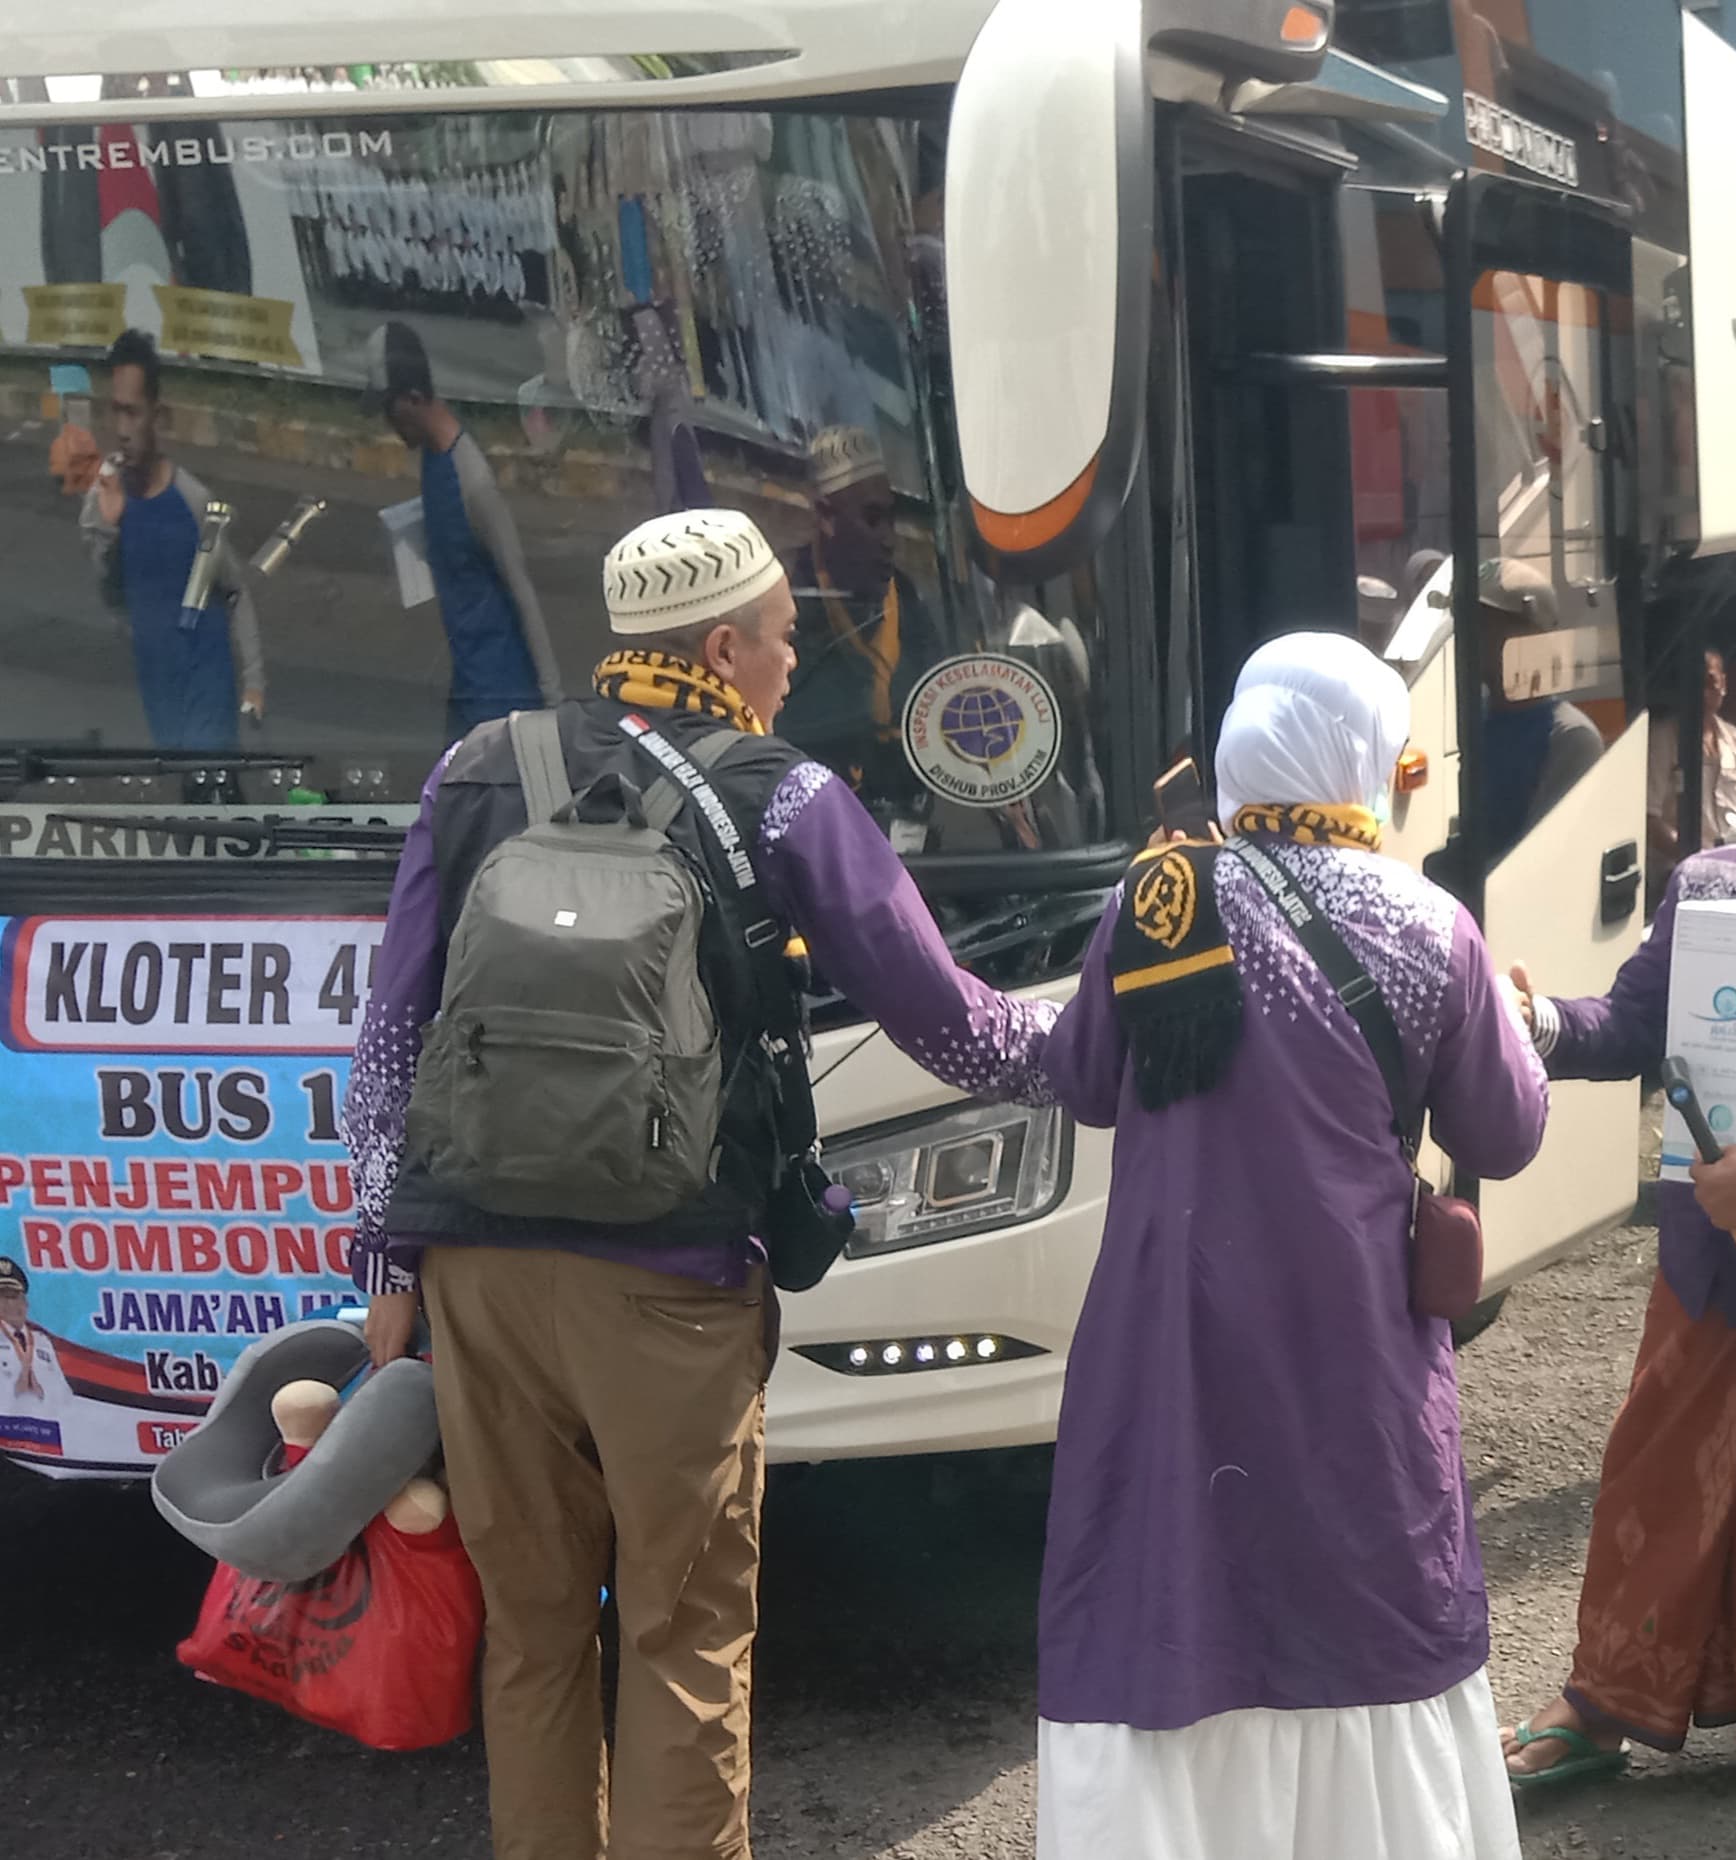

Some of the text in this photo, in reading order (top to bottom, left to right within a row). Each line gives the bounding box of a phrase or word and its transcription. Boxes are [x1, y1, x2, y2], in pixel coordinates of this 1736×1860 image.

[929, 763, 978, 796] DISHUB
[44, 940, 384, 1026] KLOTER 4
[98, 1070, 271, 1140] BUS
[93, 1290, 285, 1335] JAMA'AH
